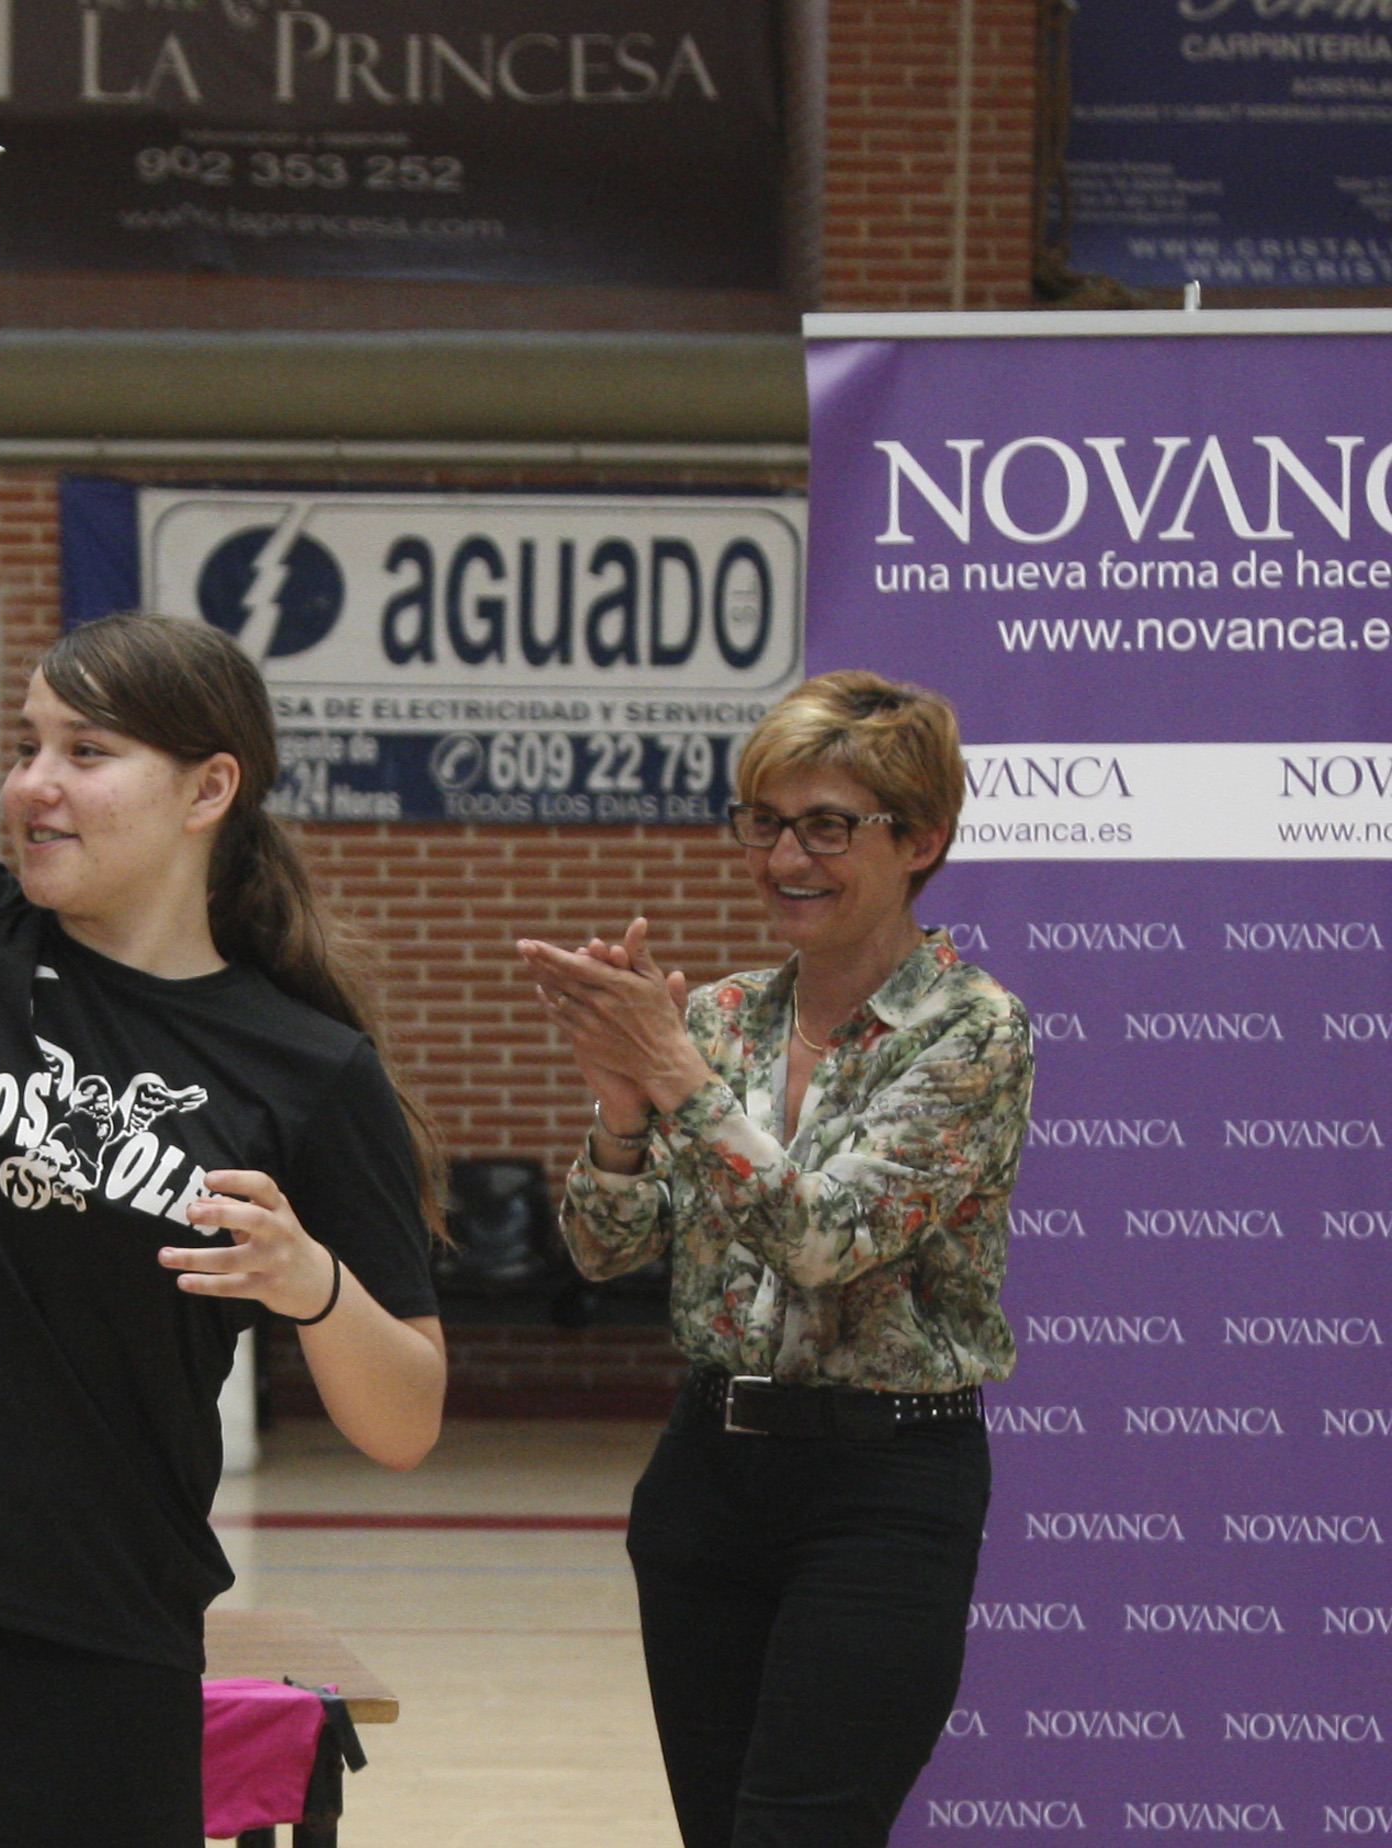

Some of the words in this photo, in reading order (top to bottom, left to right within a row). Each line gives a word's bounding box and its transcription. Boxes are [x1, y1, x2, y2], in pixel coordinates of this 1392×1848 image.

[134, 146, 233, 187] 902
[249, 150, 348, 189] 353
[365, 154, 465, 192] 252
[874, 564, 950, 592] una
[964, 561, 1087, 591] nueva
[1099, 551, 1219, 590] forma
[1232, 550, 1283, 588] de
[1296, 550, 1392, 588] hace
[997, 616, 1392, 652] www.novanca.e
[275, 697, 316, 718] SA
[324, 698, 363, 719] DE
[372, 698, 591, 721] ELECTRICIDAD
[598, 701, 617, 722] Y
[625, 701, 766, 723] SERVICIO
[489, 732, 574, 791] 609
[585, 733, 644, 791] 22
[658, 734, 715, 792] 79
[963, 757, 1134, 798] VANCA
[444, 792, 534, 817] TODOS
[540, 793, 592, 818] LOS
[666, 795, 715, 820] DEL
[959, 821, 1133, 844] novanca.es
[1027, 922, 1186, 951] NOVANCA
[1224, 922, 1384, 951] NOVANCA
[1125, 1012, 1284, 1041] NOVANCA
[1028, 1118, 1185, 1147] NOVANCA
[1223, 1119, 1384, 1148] NOVANCA
[1124, 1209, 1284, 1238] NOVANCA
[1026, 1315, 1185, 1345] NOVANCA
[1224, 1316, 1384, 1346] NOVANCA
[987, 1405, 1086, 1434] VANCA
[1124, 1406, 1284, 1436] NOVANCA
[1025, 1512, 1185, 1542] NOVANCA
[1223, 1514, 1384, 1545] NOVANCA
[1124, 1604, 1285, 1634] NOVANCA
[1026, 1710, 1185, 1740] NOVANCA
[1224, 1712, 1384, 1743] NOVANCA
[928, 1800, 1086, 1829] NOVANCA
[1124, 1802, 1285, 1832] NOVANCA
